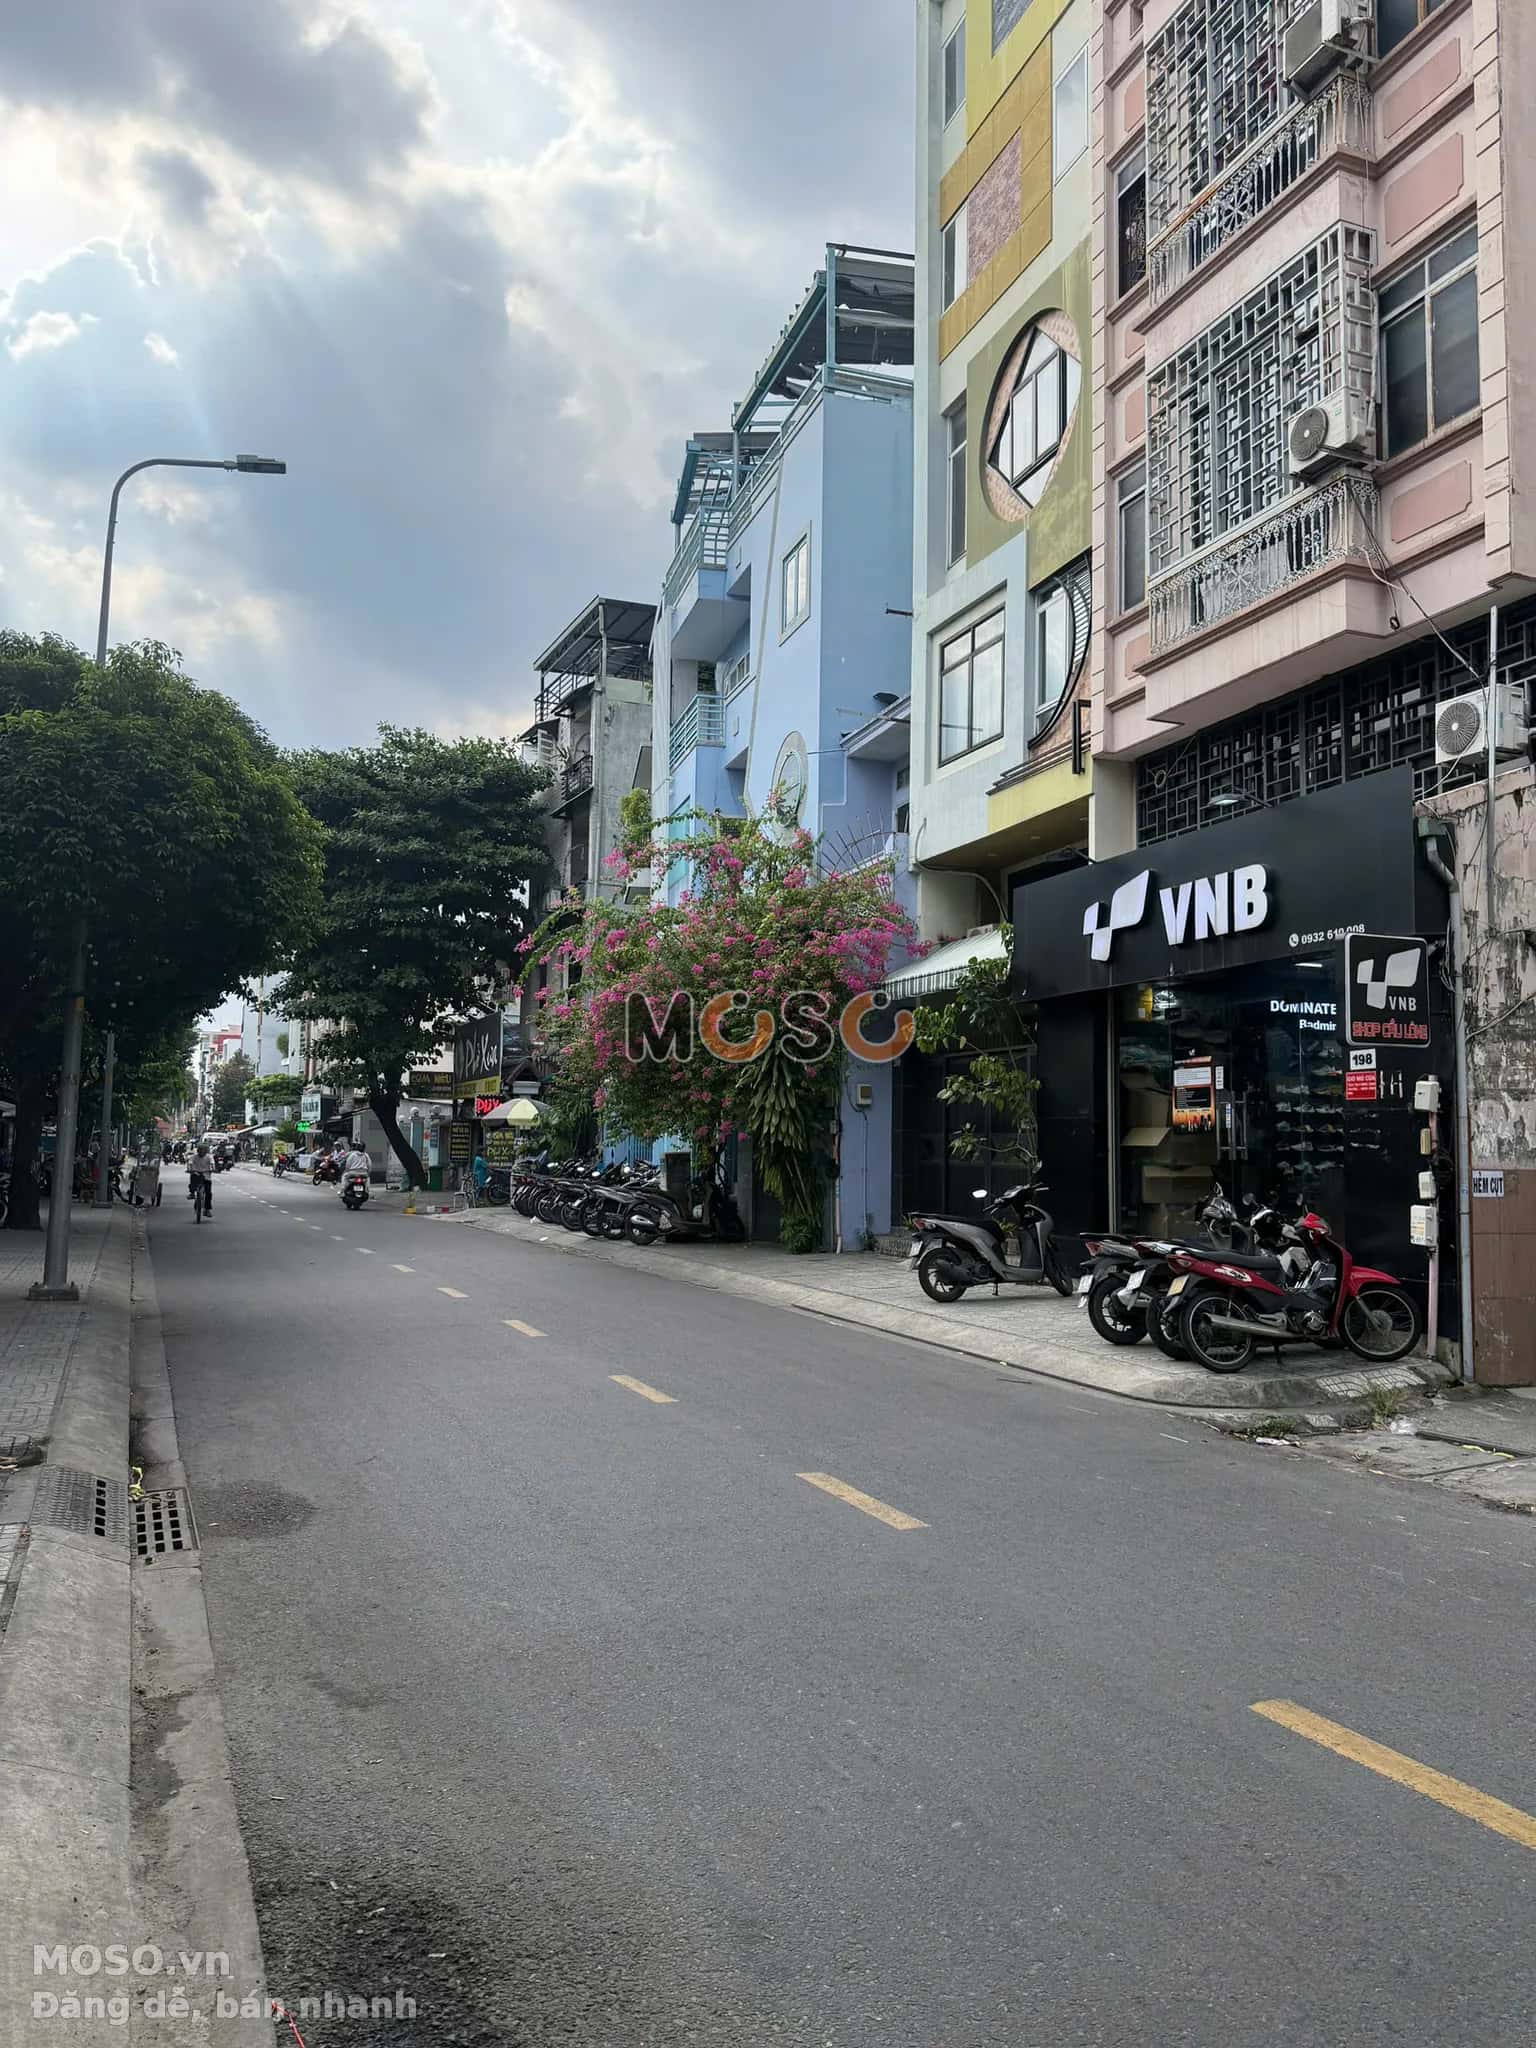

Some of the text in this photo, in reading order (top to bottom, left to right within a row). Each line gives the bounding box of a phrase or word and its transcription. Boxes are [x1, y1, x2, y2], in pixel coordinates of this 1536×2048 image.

[1159, 864, 1269, 945] VNB
[1301, 932, 1325, 945] 0932
[1270, 1000, 1336, 1015] DOMINATE
[1388, 996, 1417, 1012] VNB
[1352, 1021, 1381, 1038] SHOP
[1352, 1053, 1373, 1066] 198
